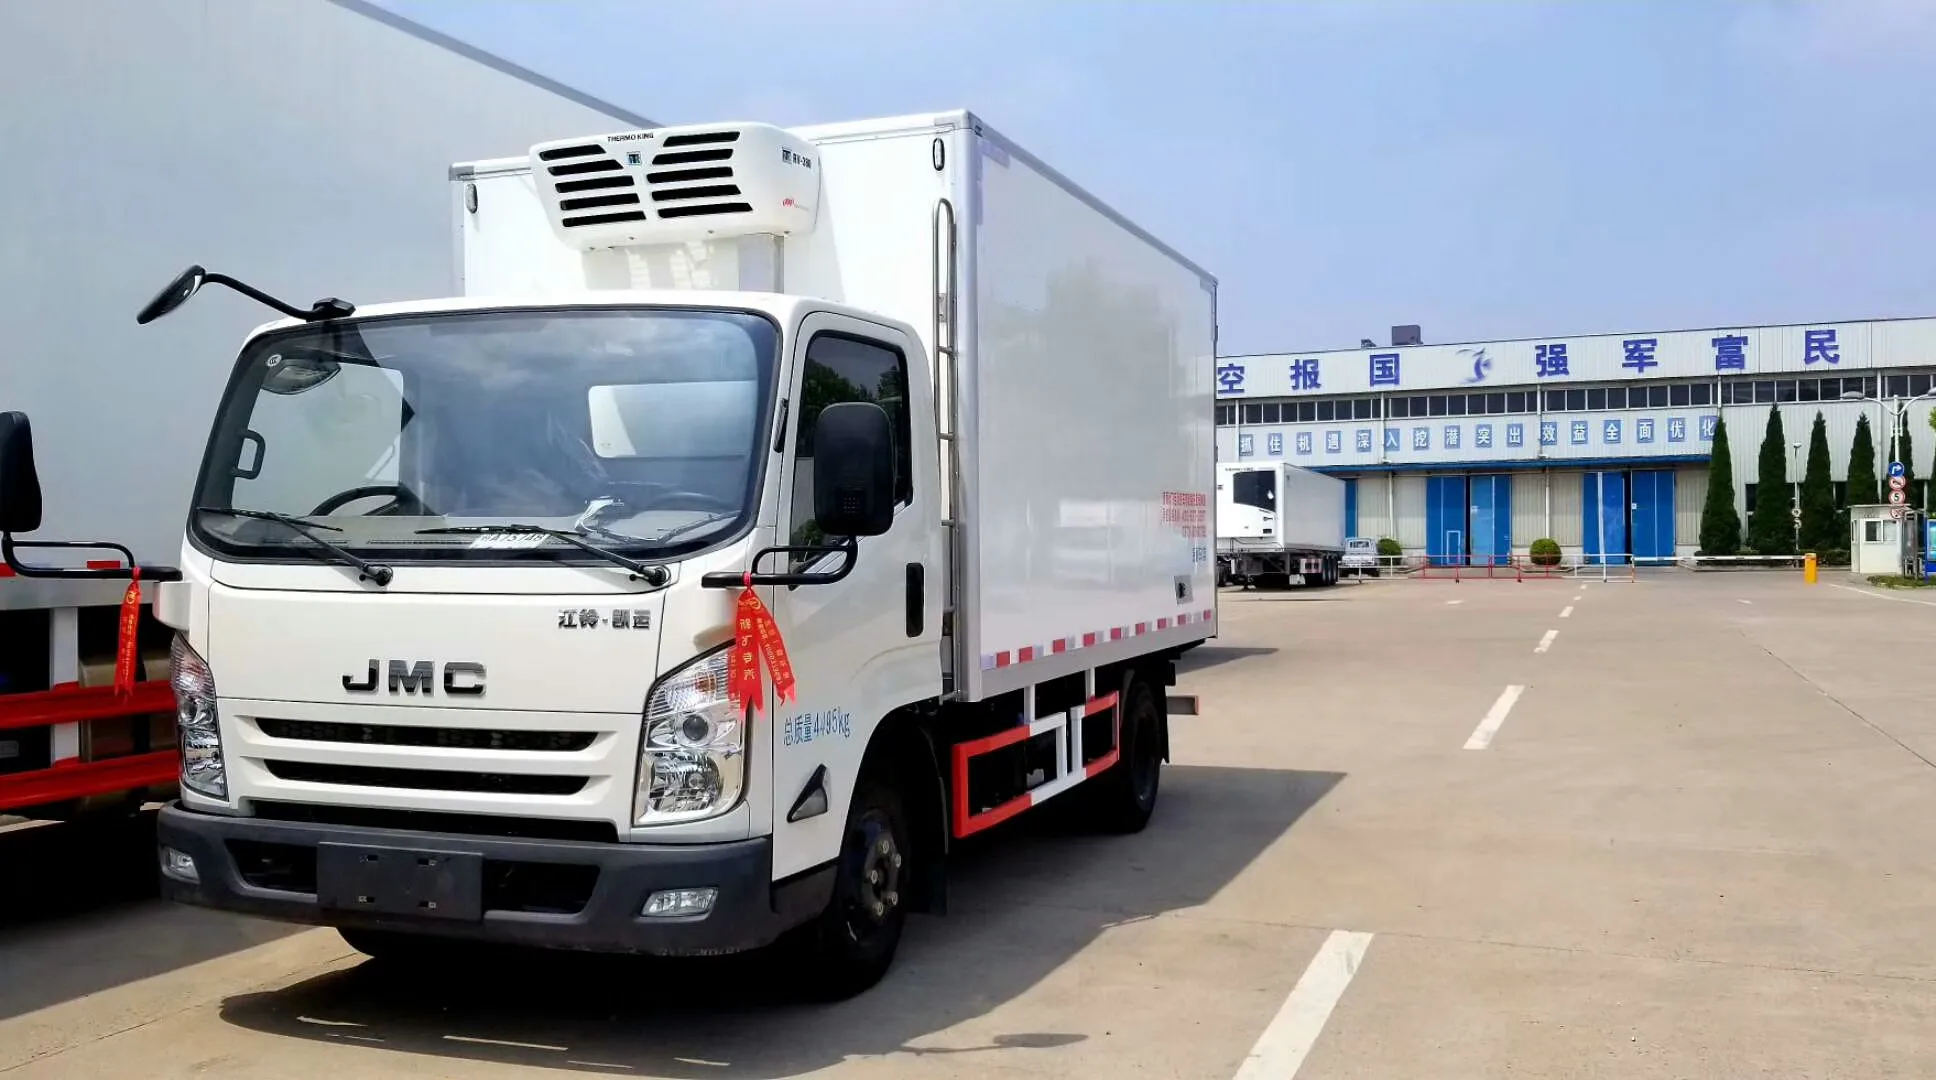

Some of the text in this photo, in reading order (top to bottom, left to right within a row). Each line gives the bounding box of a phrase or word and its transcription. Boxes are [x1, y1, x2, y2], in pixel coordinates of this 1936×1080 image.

[607, 132, 654, 142] THERMO KING
[1535, 328, 1840, 378] 强军富民
[342, 659, 486, 695] JMC
